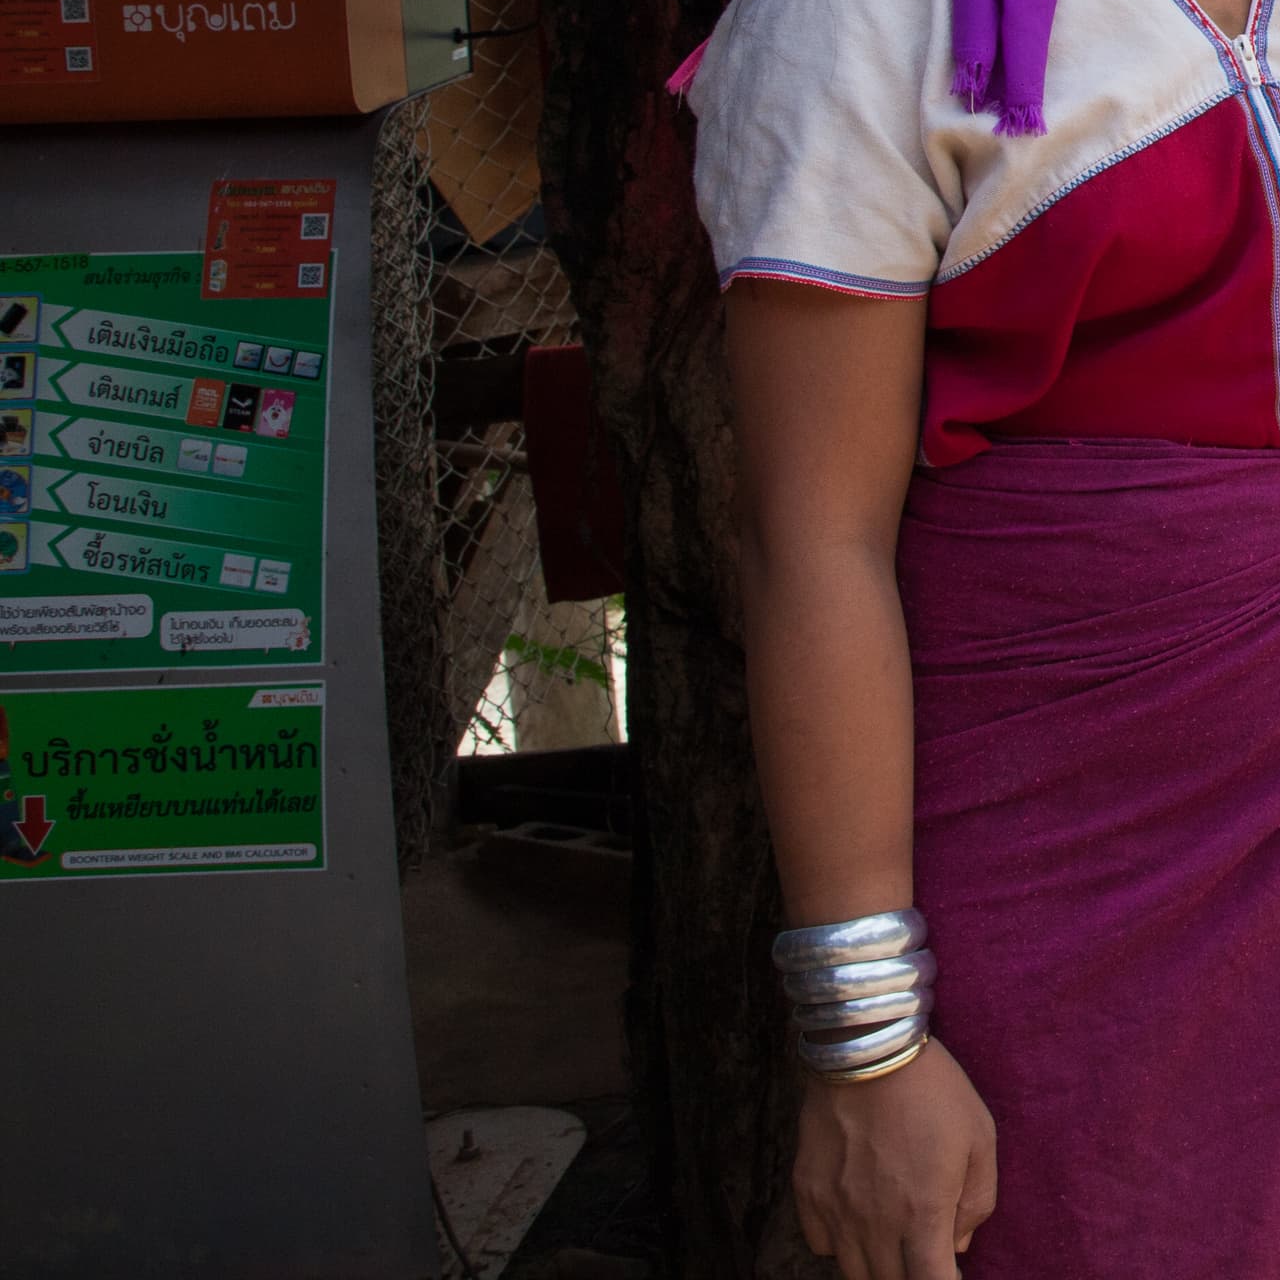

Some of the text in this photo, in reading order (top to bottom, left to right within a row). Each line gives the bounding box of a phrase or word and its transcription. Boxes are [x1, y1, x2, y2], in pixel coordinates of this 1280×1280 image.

[88, 320, 230, 364] เติมเงินมือถือ
[88, 375, 183, 410] เติมเกมส์
[88, 430, 165, 464] จ่ายบิล
[87, 481, 168, 519] โอนเงิน
[83, 533, 210, 584] ซื้อรหัสบัตร
[22, 718, 318, 778] บริการชั่งน้ำหนัก
[66, 787, 317, 820] ขึ้นเหยียบบนแท่นได้เลย
[70, 854, 125, 865] BOONTERM
[128, 852, 165, 862] WEIGHT
[168, 851, 198, 861] SCALE
[202, 850, 222, 860] AND
[245, 848, 309, 859] CALCULATOR
